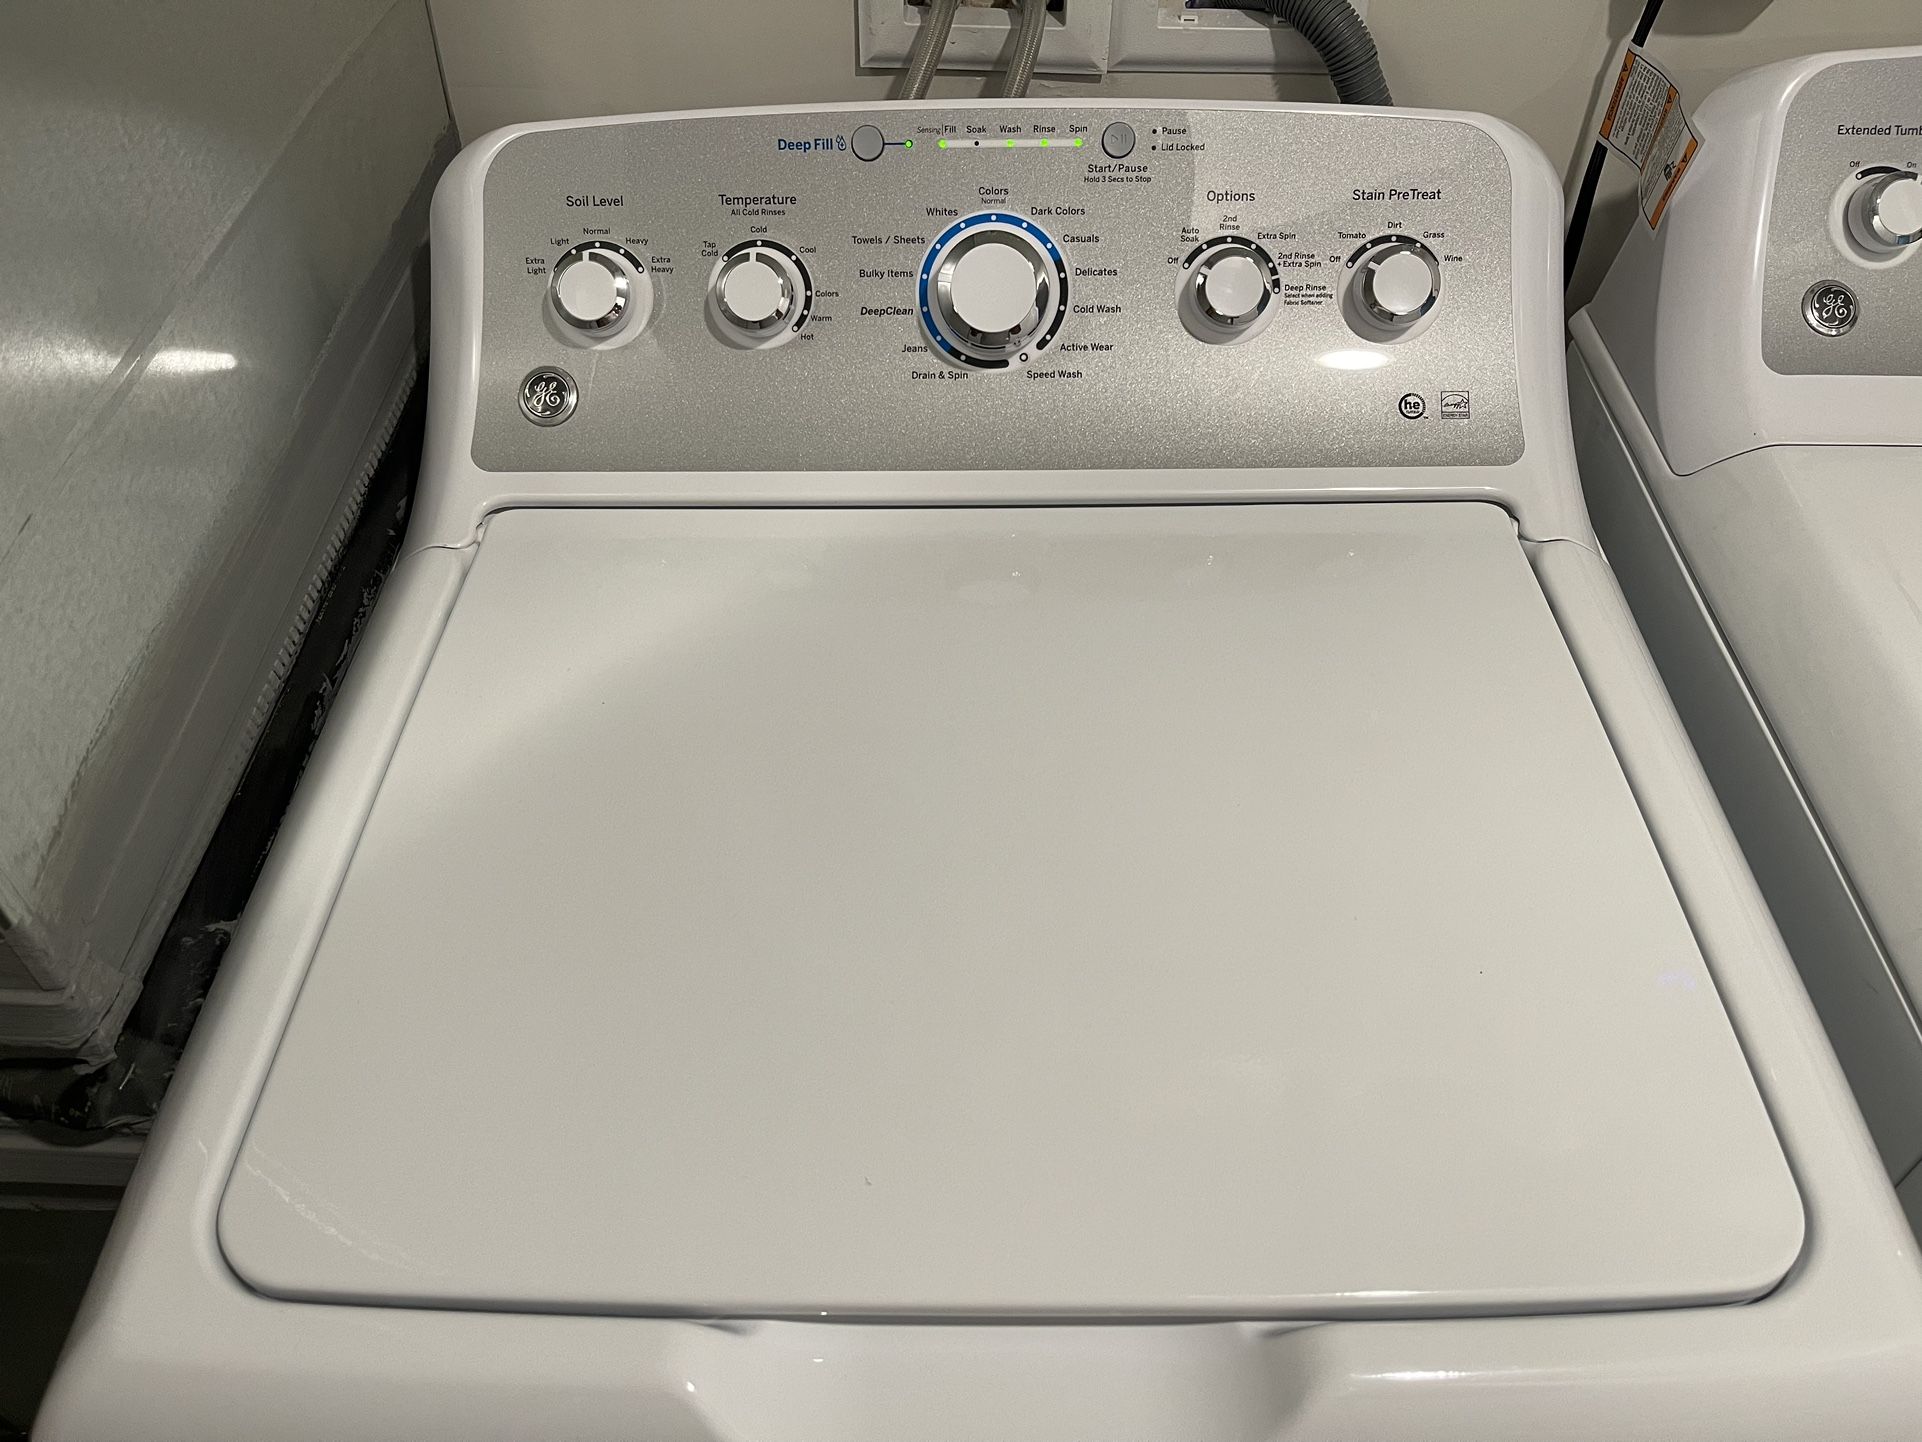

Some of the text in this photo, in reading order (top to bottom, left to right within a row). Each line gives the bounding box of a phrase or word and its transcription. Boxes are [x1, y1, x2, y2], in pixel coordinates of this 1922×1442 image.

[1000, 125, 1021, 133] Wash
[1069, 125, 1087, 134] Spin
[1838, 125, 1891, 135] Extended
[778, 138, 833, 152] Deep Fill
[1162, 143, 1205, 151] Lid Locked
[1088, 164, 1147, 173] Start/Pause
[979, 187, 1008, 195] Colors
[1353, 189, 1441, 200] Stain PreTreat
[567, 196, 623, 206] Soil Level
[718, 194, 796, 207] Temperature
[1207, 191, 1255, 204] Options
[926, 208, 958, 216] Whites
[1031, 207, 1085, 215] Dark Colors
[852, 236, 882, 244] Towels
[894, 235, 925, 244] Sheets
[1063, 234, 1099, 242] Casuals
[1279, 232, 1296, 240] Spin
[551, 238, 569, 246] Light
[703, 241, 716, 249] Tap
[1305, 260, 1321, 269] Spin
[527, 267, 546, 275] Light
[651, 266, 673, 274] Heavy
[860, 269, 913, 279] Bulky Items
[1076, 268, 1117, 276] Delicates
[1285, 284, 1303, 292] Deep
[861, 307, 913, 317] DeepClean
[1073, 305, 1121, 313] Cold Wash
[901, 344, 928, 352] Jeans
[1060, 343, 1113, 351] Active Wear
[912, 371, 968, 381] Drain & Spin
[1027, 370, 1082, 380] Speed Wash
[1404, 399, 1420, 410] he
